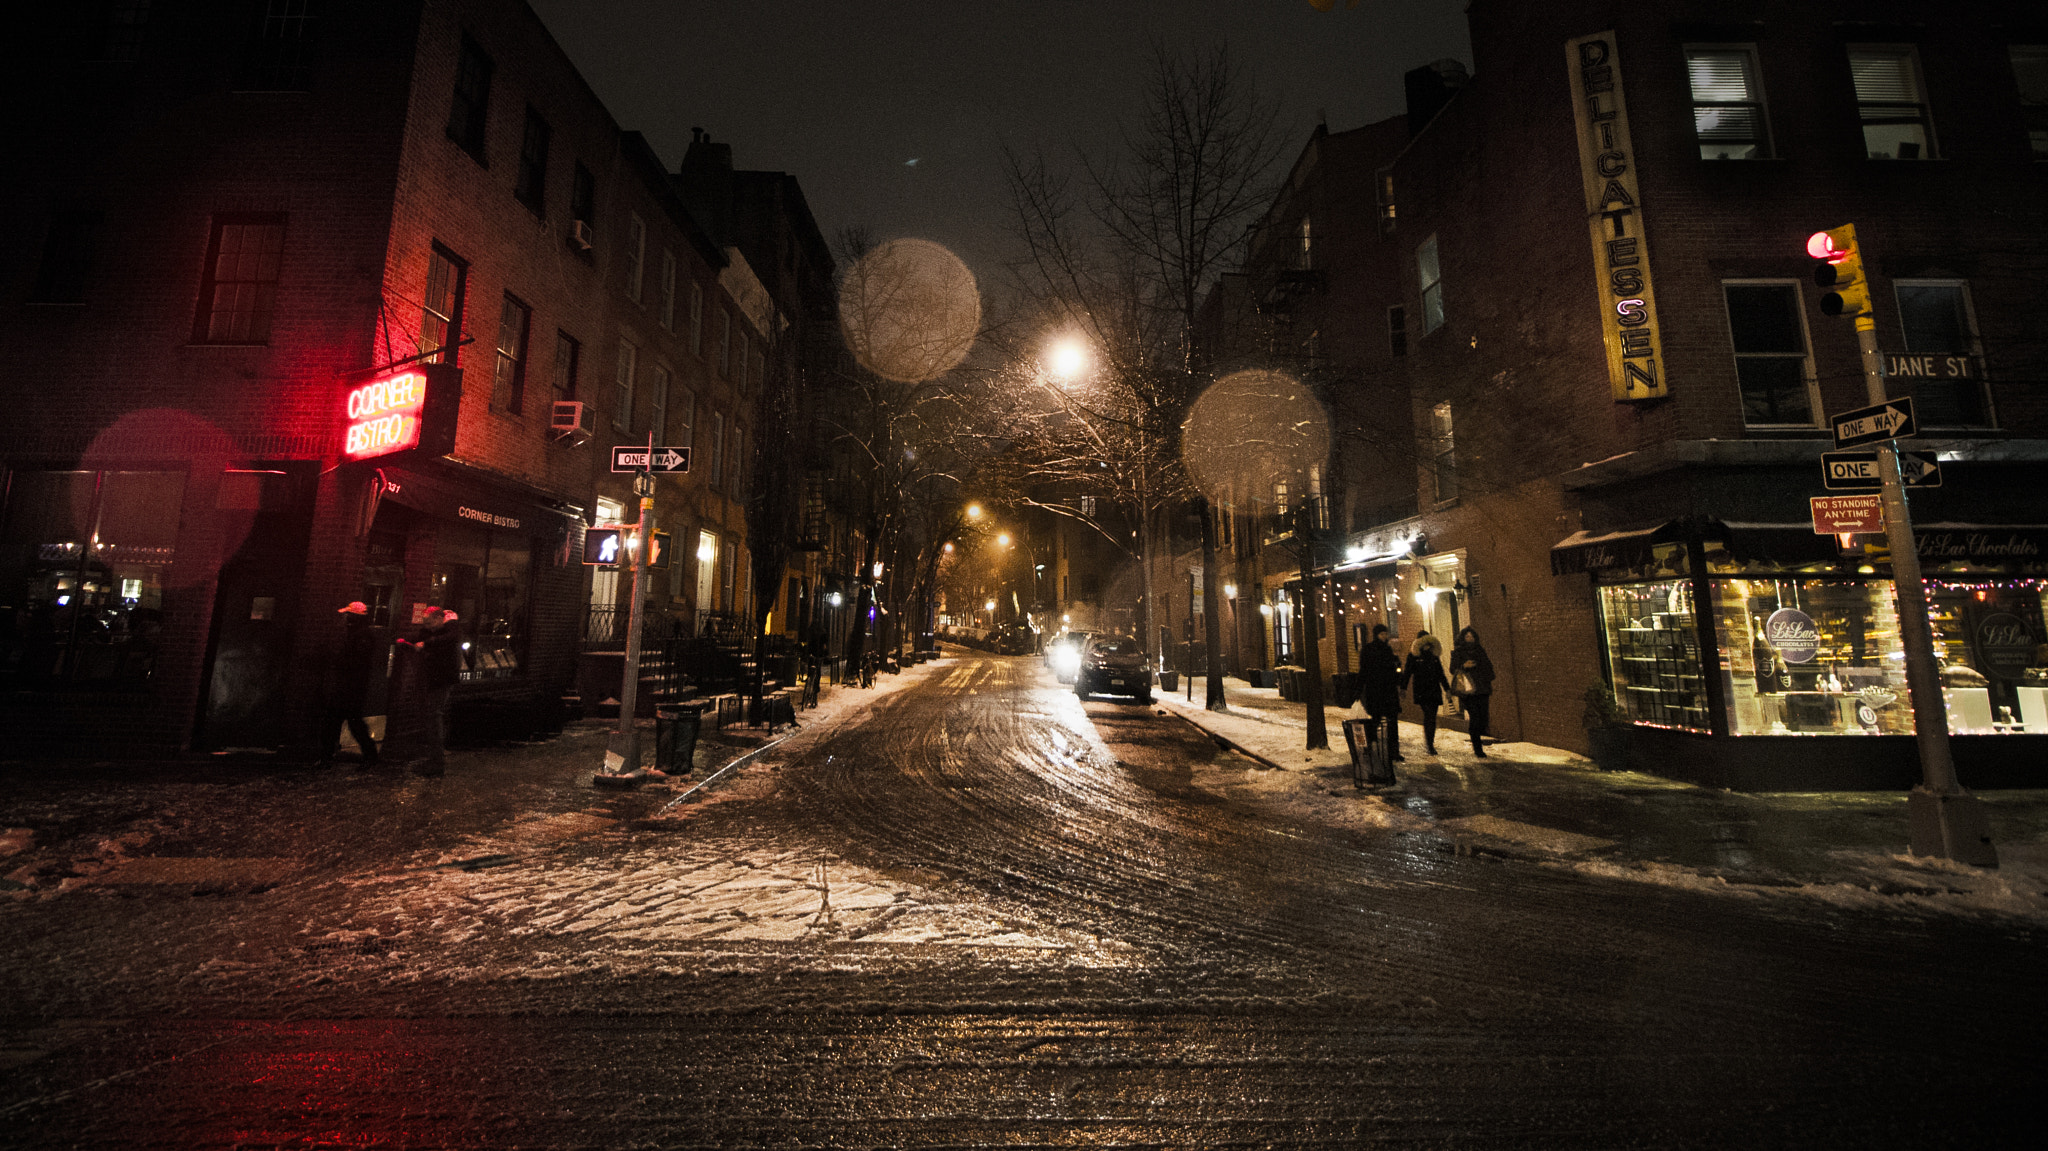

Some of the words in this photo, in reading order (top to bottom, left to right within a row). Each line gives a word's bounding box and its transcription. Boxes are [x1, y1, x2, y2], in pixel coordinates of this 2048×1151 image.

[1578, 39, 1659, 391] DELICATESSEN
[1889, 356, 1937, 377] JANE
[1946, 356, 1968, 377] ST
[348, 372, 417, 419] CORNER
[346, 413, 403, 454] BISTRO
[1843, 421, 1866, 438] ONE
[1873, 412, 1900, 431] WAY
[624, 454, 646, 465] ONE
[656, 454, 678, 465] WAY
[1833, 463, 1871, 477] ONE
[1815, 501, 1828, 509] NO
[1831, 499, 1876, 509] STANDING
[1824, 510, 1871, 519] ANYTIME
[458, 505, 493, 524] CORNER
[493, 514, 520, 529] BISTRO
